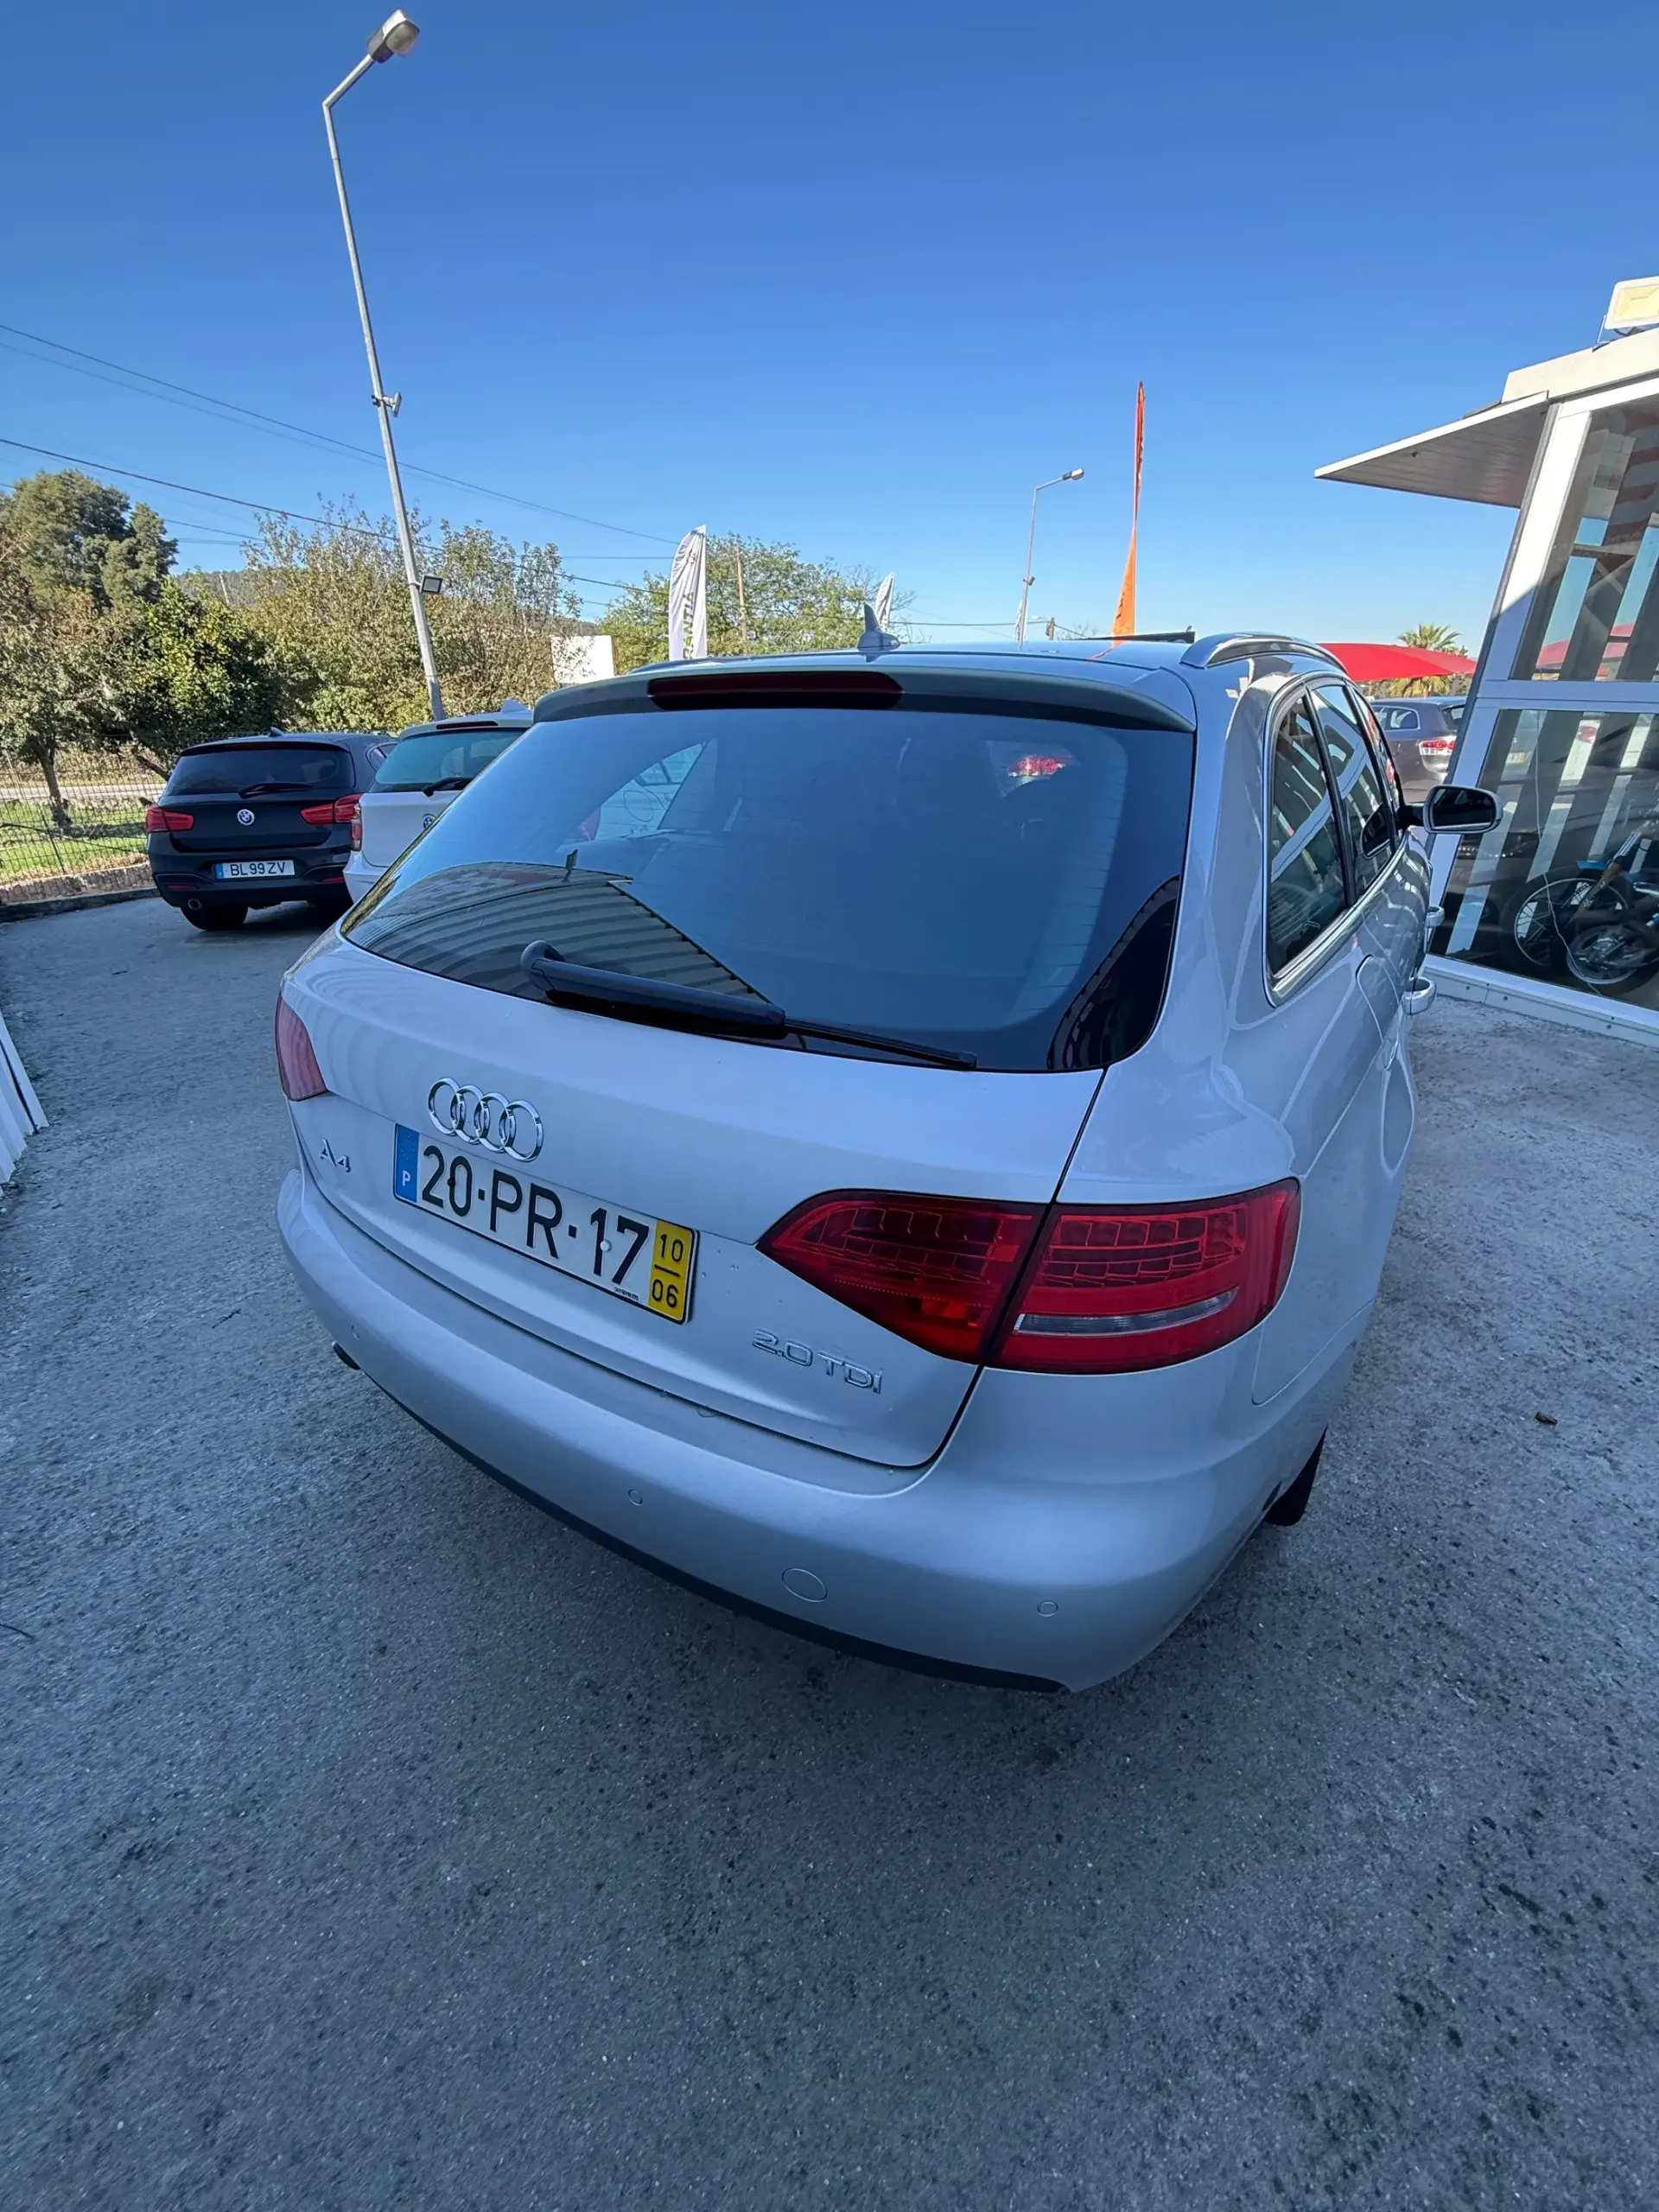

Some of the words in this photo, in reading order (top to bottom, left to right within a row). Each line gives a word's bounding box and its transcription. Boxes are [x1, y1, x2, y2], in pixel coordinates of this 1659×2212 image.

[230, 863, 248, 876] BL
[249, 862, 265, 874] 99
[267, 861, 286, 874] ZV
[319, 1137, 352, 1173] A4
[402, 1170, 411, 1186] P
[659, 1233, 684, 1263] 10
[652, 1278, 679, 1308] 06
[752, 1327, 814, 1368] 2.0
